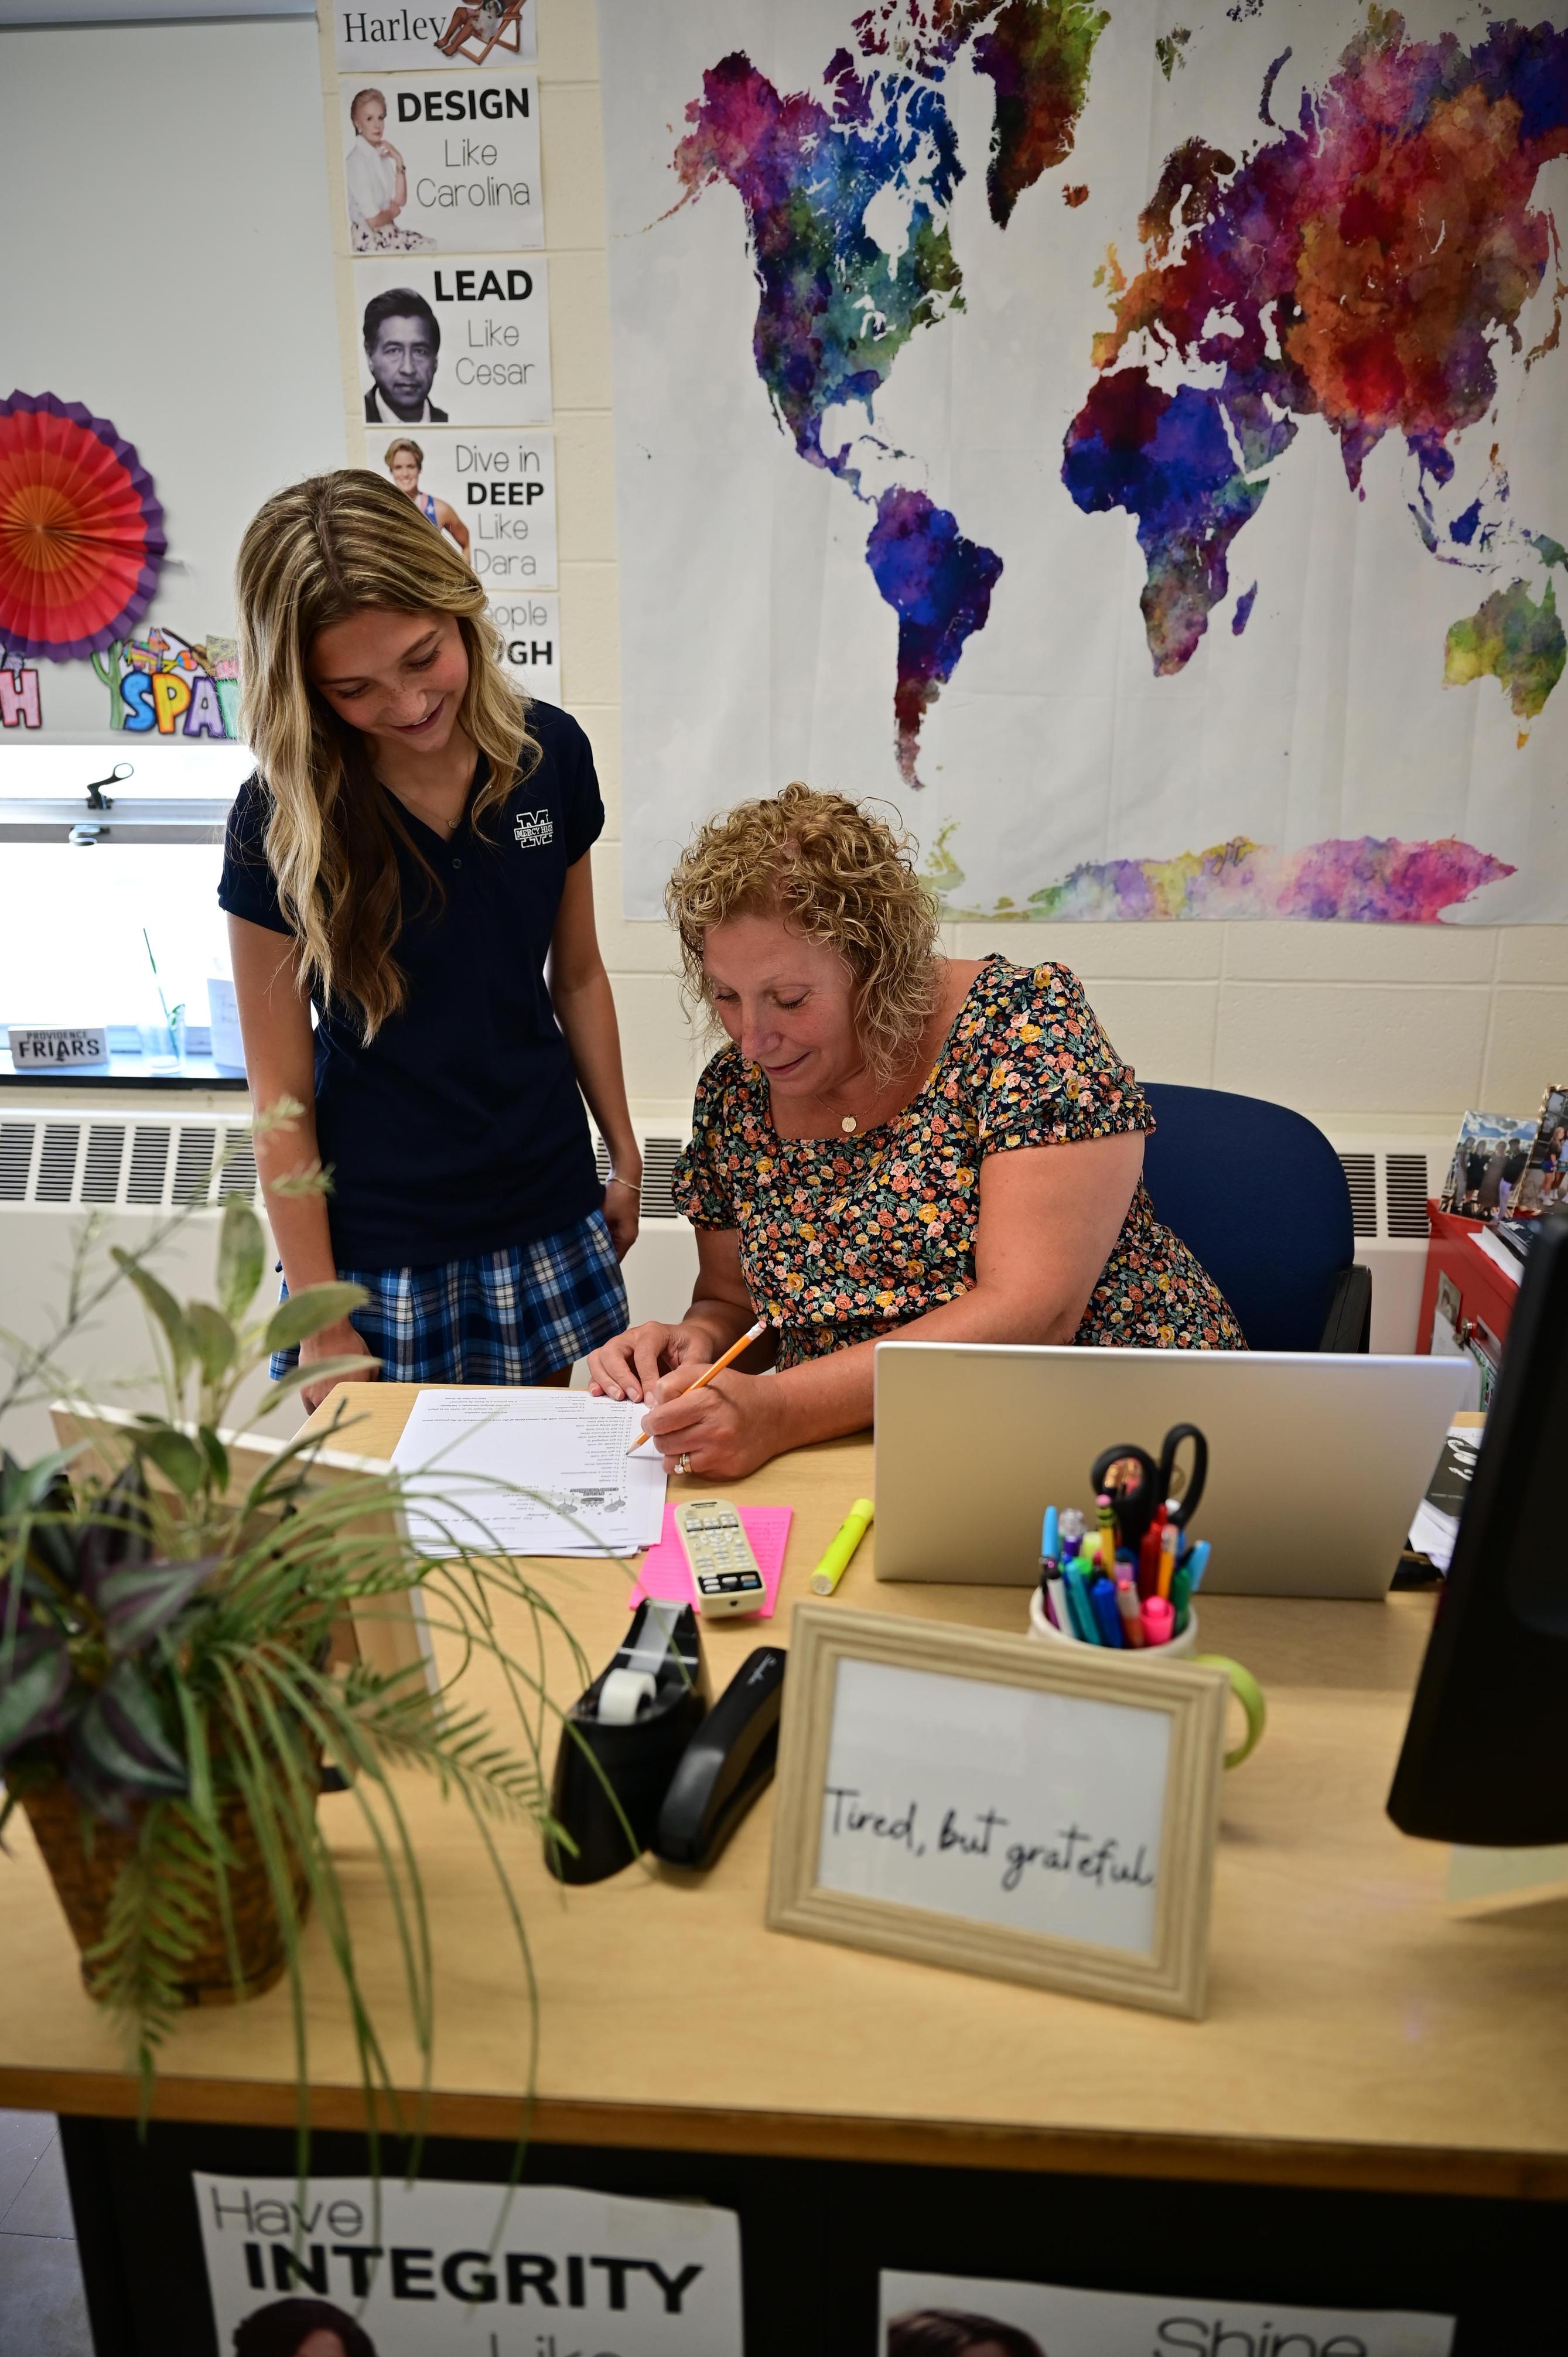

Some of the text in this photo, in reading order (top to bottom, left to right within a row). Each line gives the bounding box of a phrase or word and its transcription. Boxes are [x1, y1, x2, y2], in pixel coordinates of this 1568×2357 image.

[397, 88, 530, 122] DESIGN
[445, 138, 498, 168] Like
[416, 176, 530, 208] Carolina
[434, 270, 534, 302] LEAD
[468, 319, 520, 347] Like
[455, 357, 535, 386] Cesar
[456, 445, 540, 473] Dive in
[467, 481, 544, 505] DEEP
[478, 513, 528, 541] Like
[474, 548, 537, 576] Dara
[489, 600, 548, 631] ople
[496, 640, 552, 665] GH
[0, 669, 42, 729] H
[516, 824, 553, 838] MERCY HIG
[19, 1039, 100, 1058] FRIARS
[27, 1031, 87, 1040] PROVIDENCE
[824, 1787, 925, 1857] Tired,
[940, 1808, 1010, 1854] but
[211, 2186, 364, 2238] Have
[244, 2242, 703, 2314] INTEGRITY
